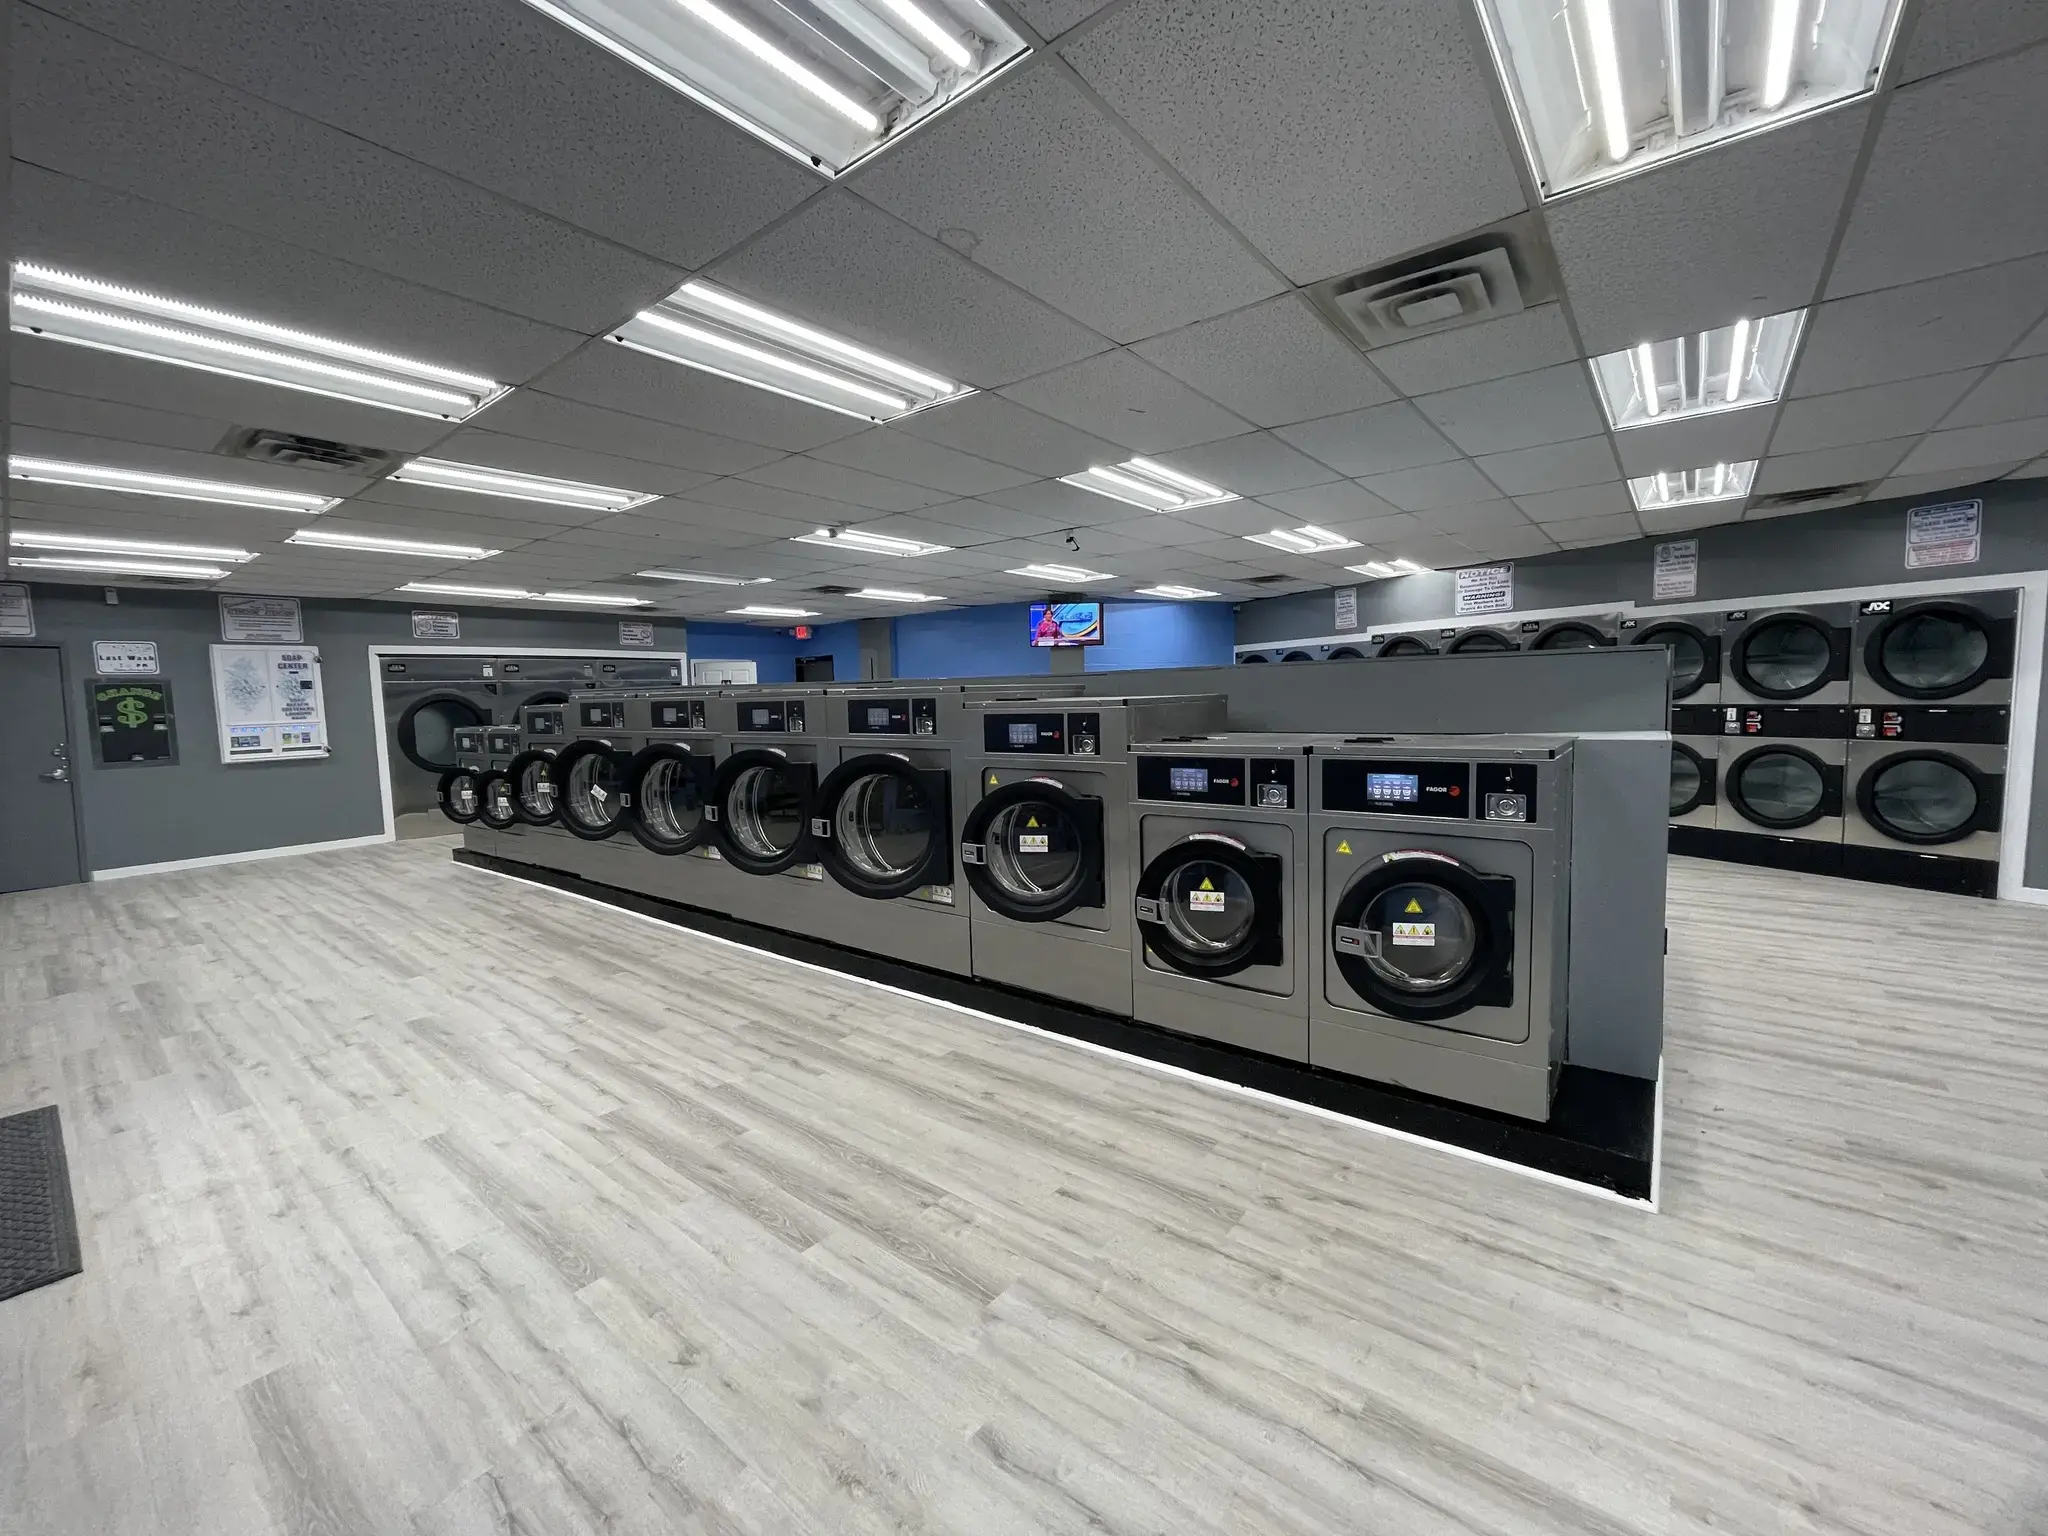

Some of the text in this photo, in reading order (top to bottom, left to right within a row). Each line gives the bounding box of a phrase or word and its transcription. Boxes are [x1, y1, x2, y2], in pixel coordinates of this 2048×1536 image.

[1460, 567, 1508, 578] NOTICE
[1464, 591, 1505, 600] WARNING!
[96, 687, 162, 701] CHANGE
